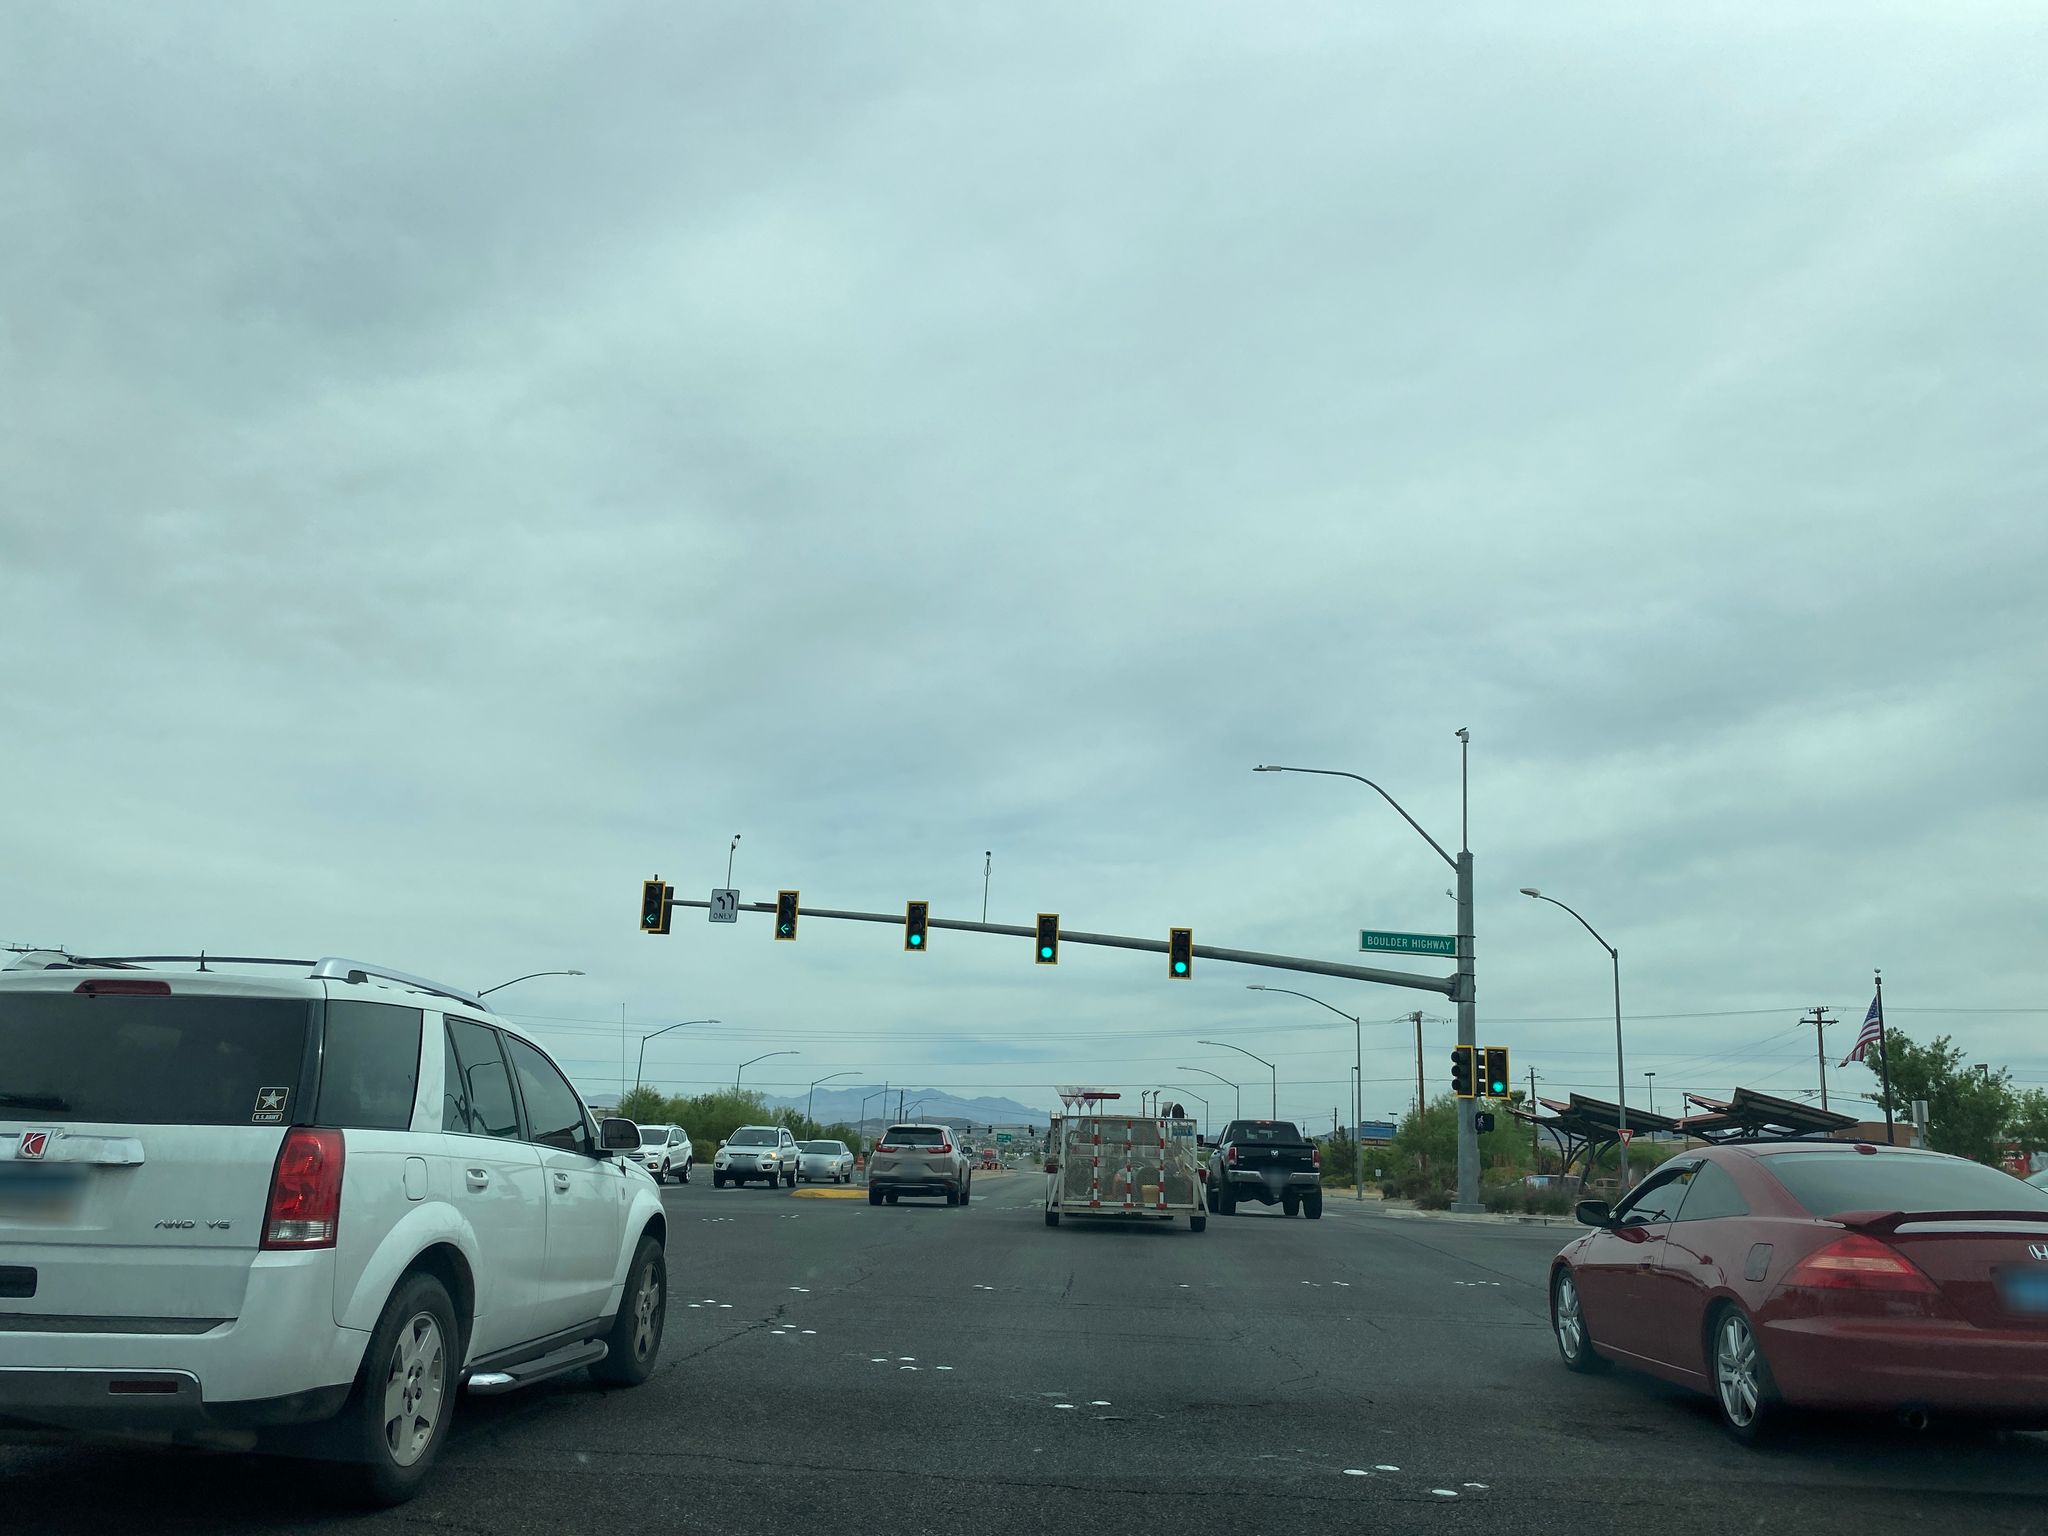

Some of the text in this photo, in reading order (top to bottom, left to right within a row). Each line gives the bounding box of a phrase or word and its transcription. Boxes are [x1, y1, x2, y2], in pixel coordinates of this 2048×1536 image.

[713, 912, 733, 920] ONLY
[1367, 935, 1451, 951] BOULDER HIGHWAY
[154, 1219, 231, 1230] AWD V6
